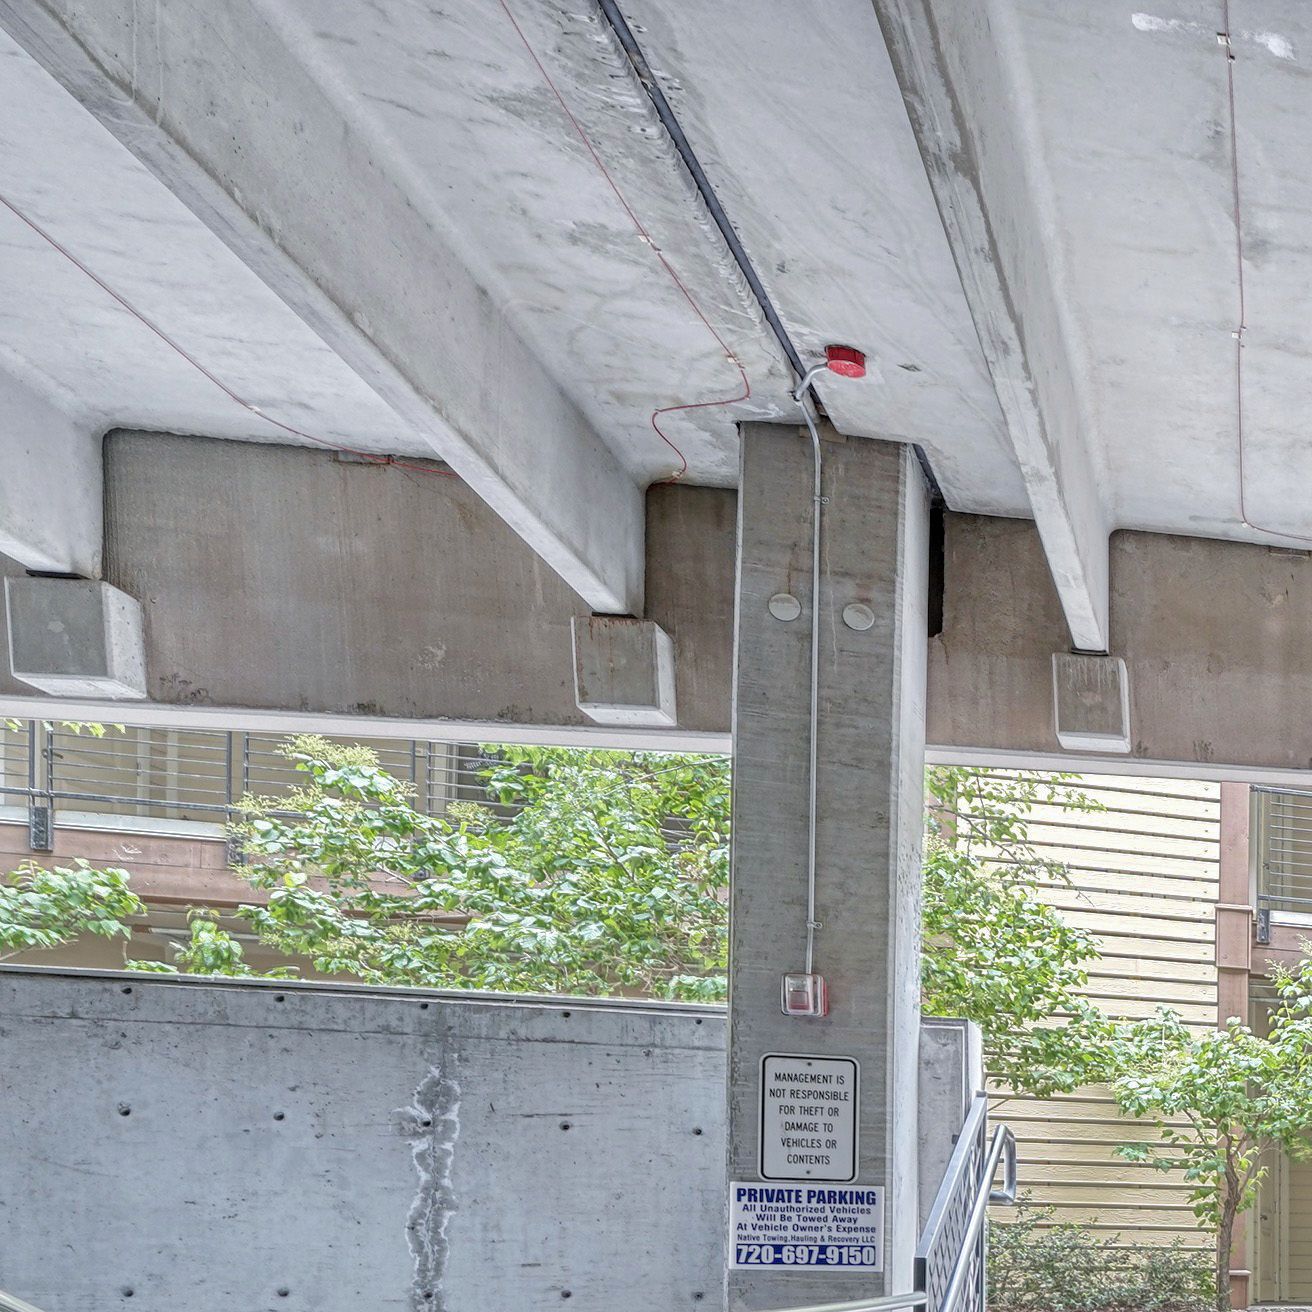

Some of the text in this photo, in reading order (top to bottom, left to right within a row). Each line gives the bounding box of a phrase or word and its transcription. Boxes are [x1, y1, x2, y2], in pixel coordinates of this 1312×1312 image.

[774, 1072, 845, 1085] MANAGEMENT IS
[769, 1088, 849, 1102] NOT RESPONSIBLE
[779, 1104, 840, 1117] FOR THEFT OR
[784, 1121, 834, 1133] DAMAGE TO
[780, 1137, 837, 1149] VEHICLES OR
[786, 1153, 831, 1165] CONTENTS
[736, 1188, 877, 1206] PRIVATE PARKING
[742, 1203, 872, 1215] All Unauthorized Vehicles
[756, 1213, 859, 1225] Will Be Towed Away
[736, 1222, 877, 1235] At Vehicle Owner's Expense
[737, 1233, 761, 1242] Native
[820, 1235, 826, 1243] &
[828, 1235, 860, 1244] Recovery
[862, 1235, 876, 1243] LLC
[737, 1245, 876, 1265] 720-697-9150
